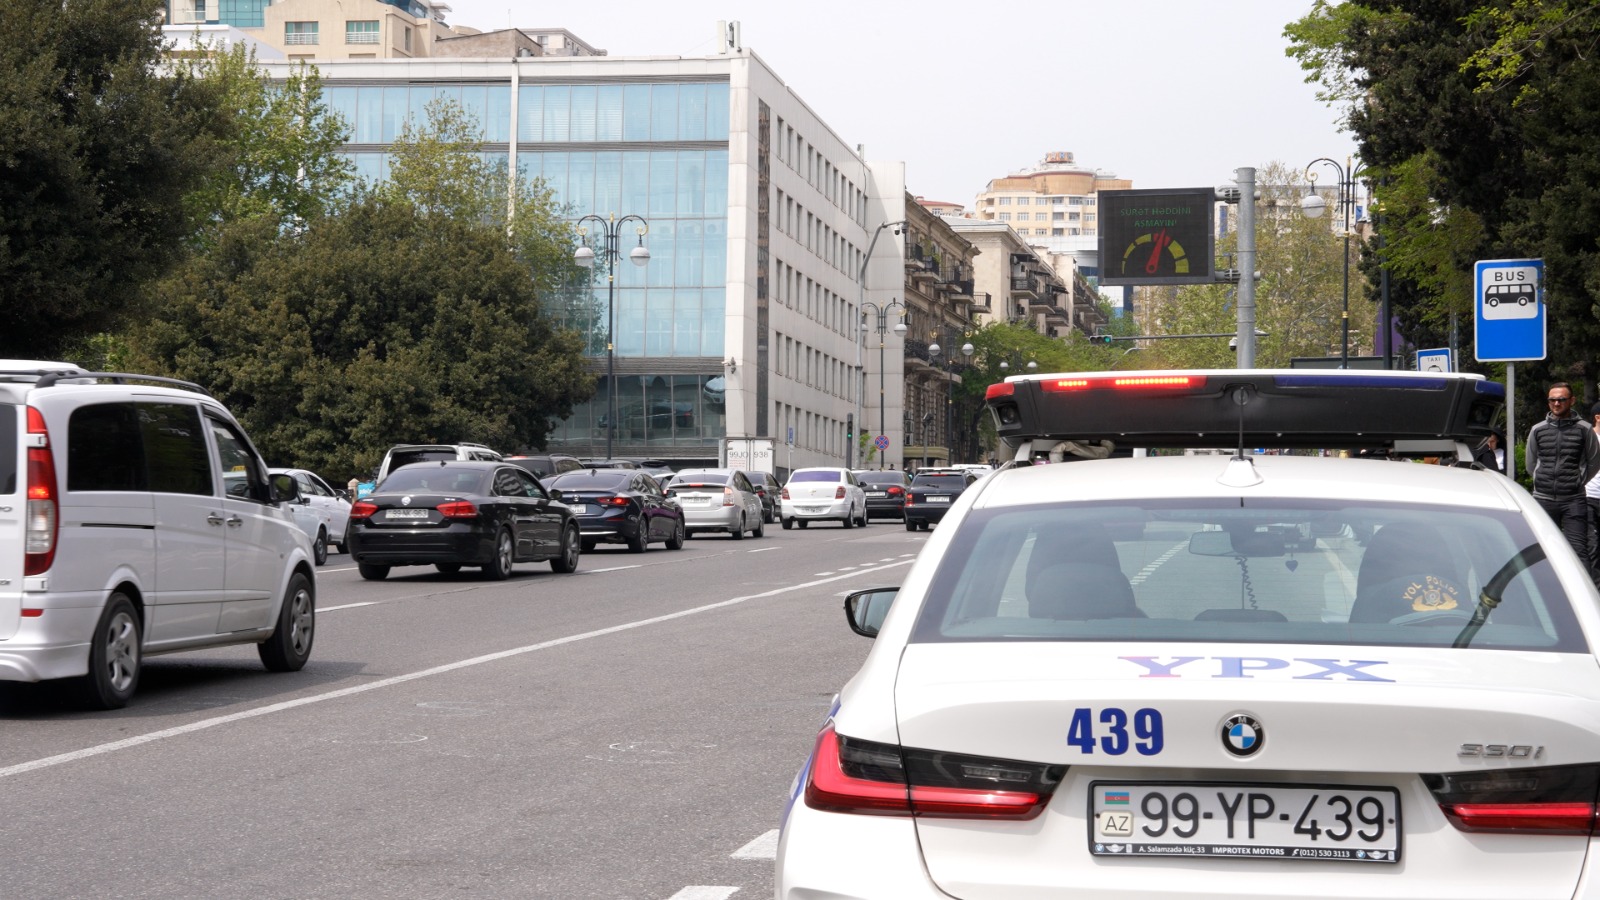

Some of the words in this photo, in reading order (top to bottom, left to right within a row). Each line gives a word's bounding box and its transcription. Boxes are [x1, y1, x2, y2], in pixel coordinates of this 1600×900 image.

[1494, 271, 1525, 281] BUS
[1402, 582, 1422, 600] YOL
[1116, 656, 1397, 683] YPX
[1066, 707, 1164, 756] 439
[1104, 815, 1129, 832] AZ
[1141, 791, 1385, 843] 99-YP-439
[1212, 847, 1251, 855] IMPROTEX
[1252, 848, 1285, 856] MOTORS
[1299, 849, 1318, 858] (012)
[1333, 850, 1350, 858] 3113
